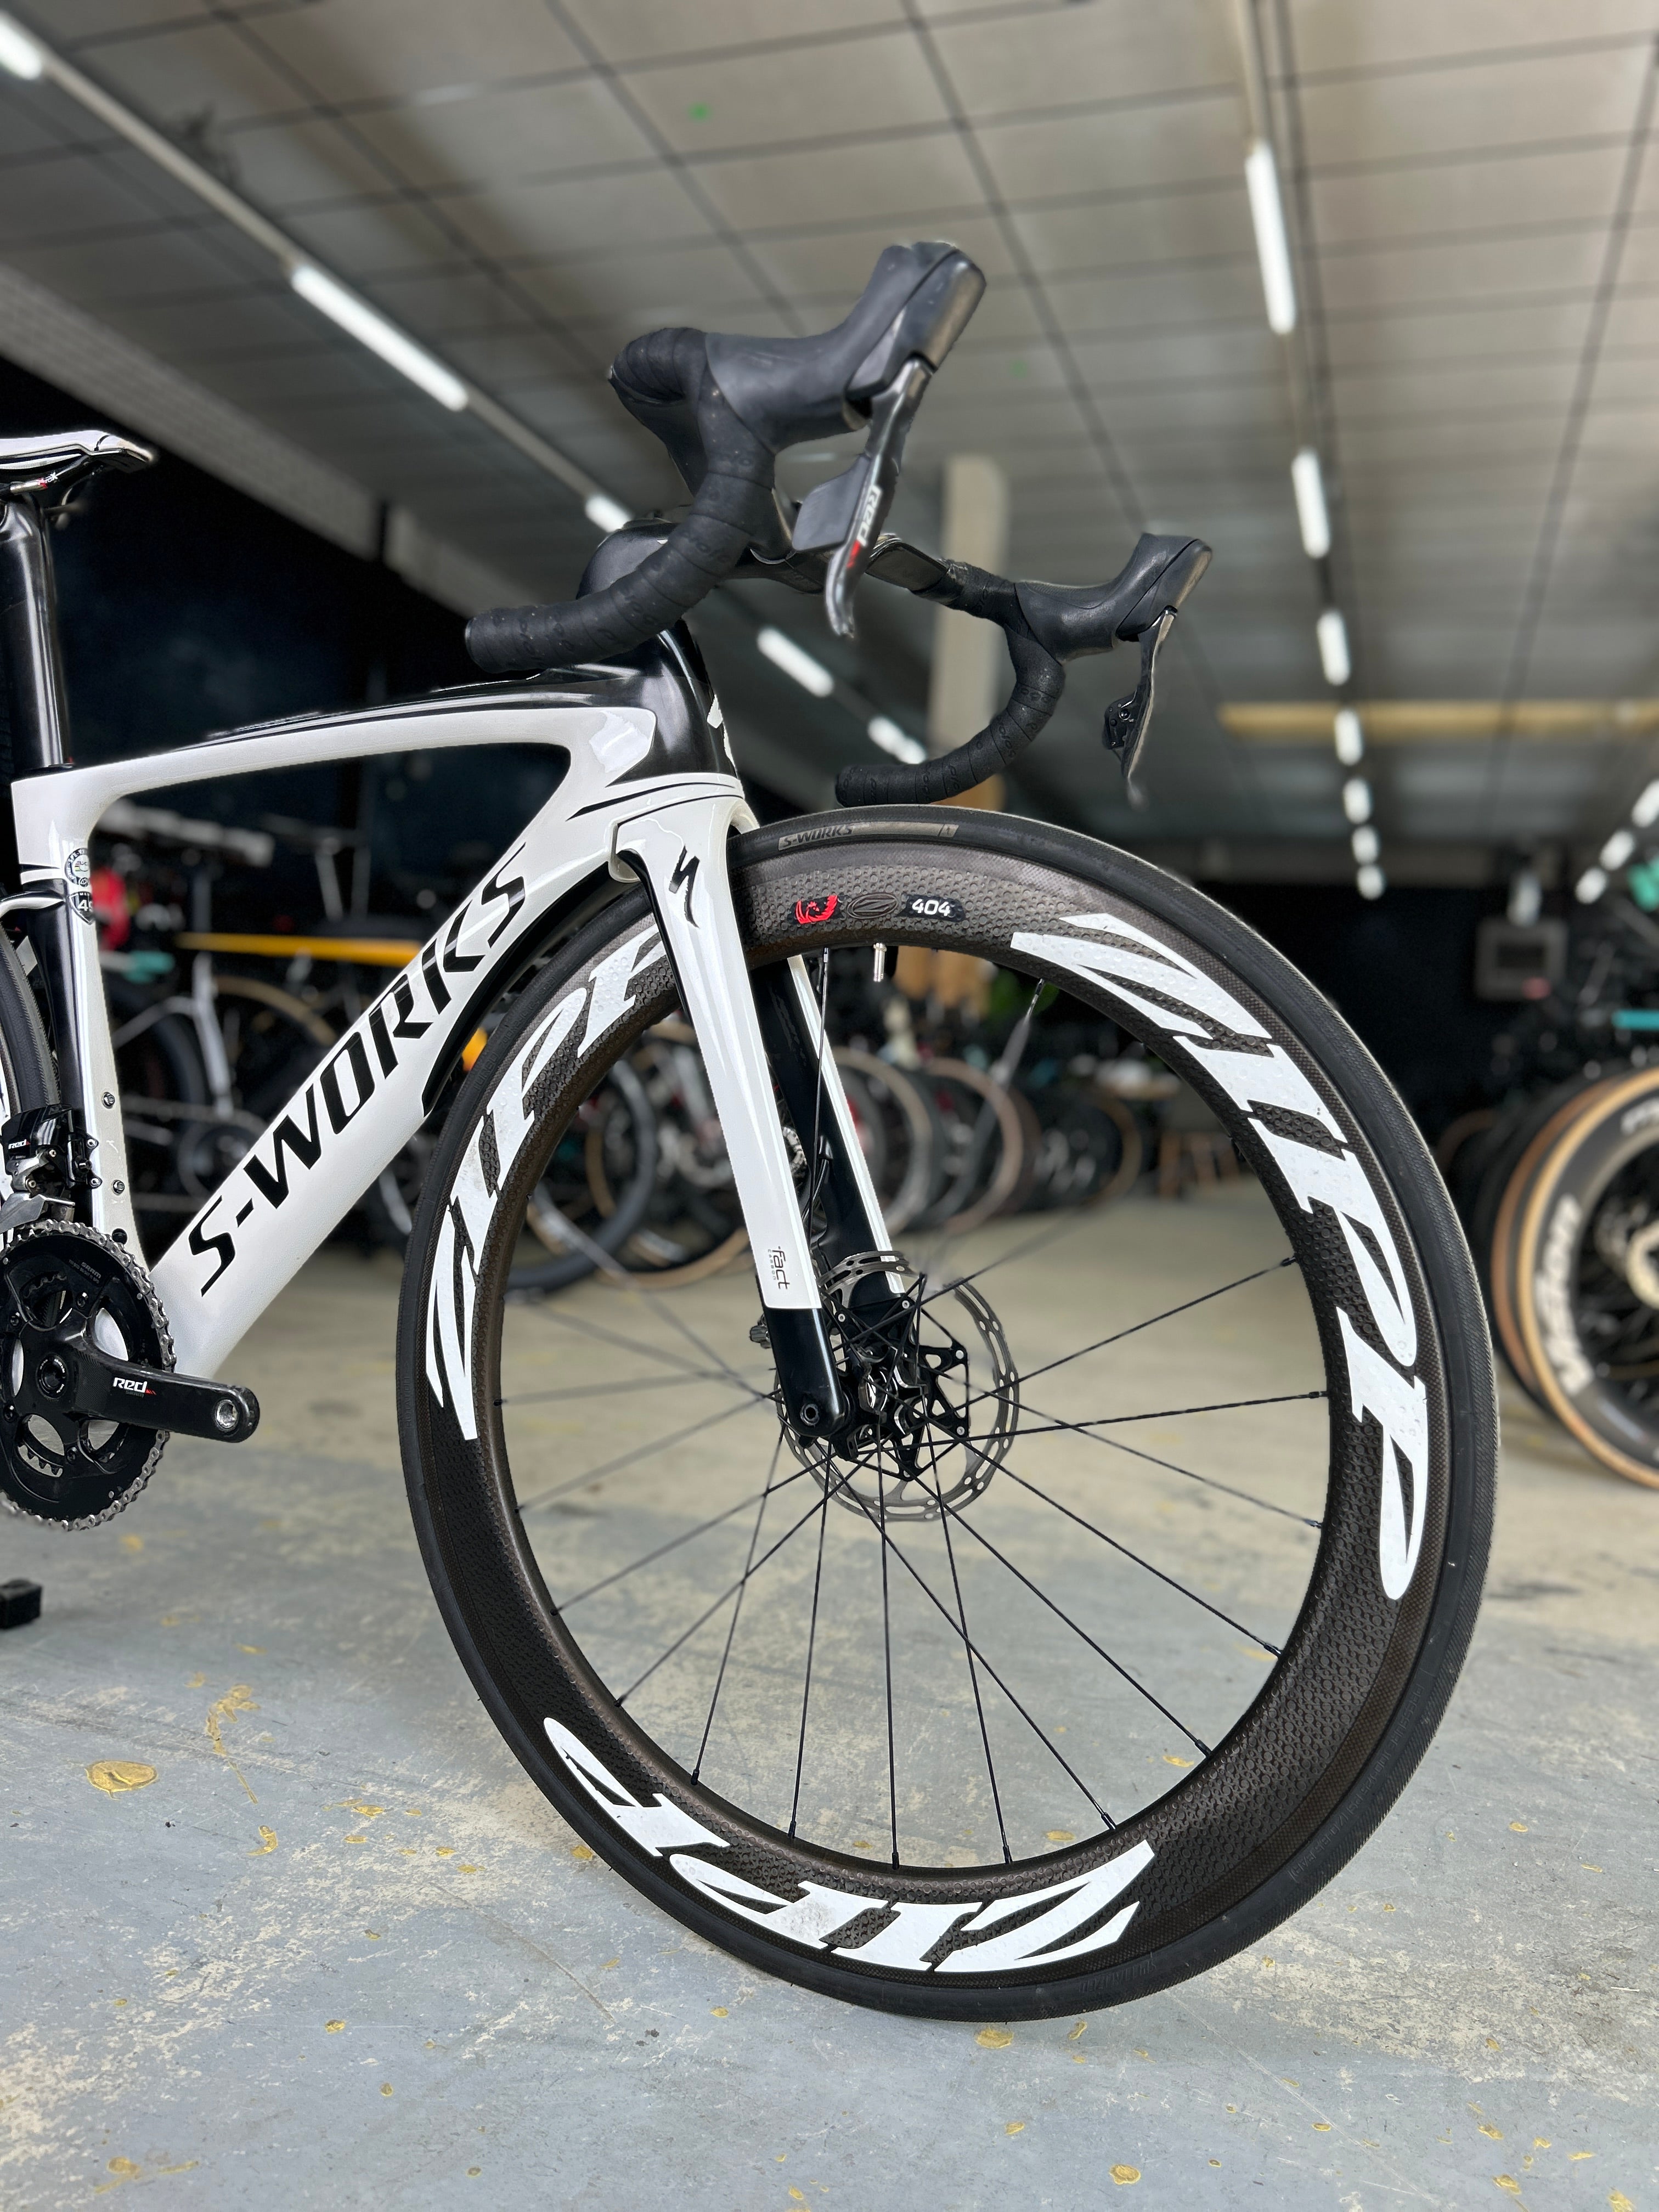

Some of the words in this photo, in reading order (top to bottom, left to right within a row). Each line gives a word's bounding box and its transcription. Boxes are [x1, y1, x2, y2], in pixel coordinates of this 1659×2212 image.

[783, 825, 853, 848] S-WORKS
[912, 899, 951, 916] 404
[188, 843, 527, 1297] S-WORKS
[772, 1246, 790, 1290] fact
[1010, 912, 1429, 1600] ZIPP
[544, 1716, 1155, 1973] ZIPP
